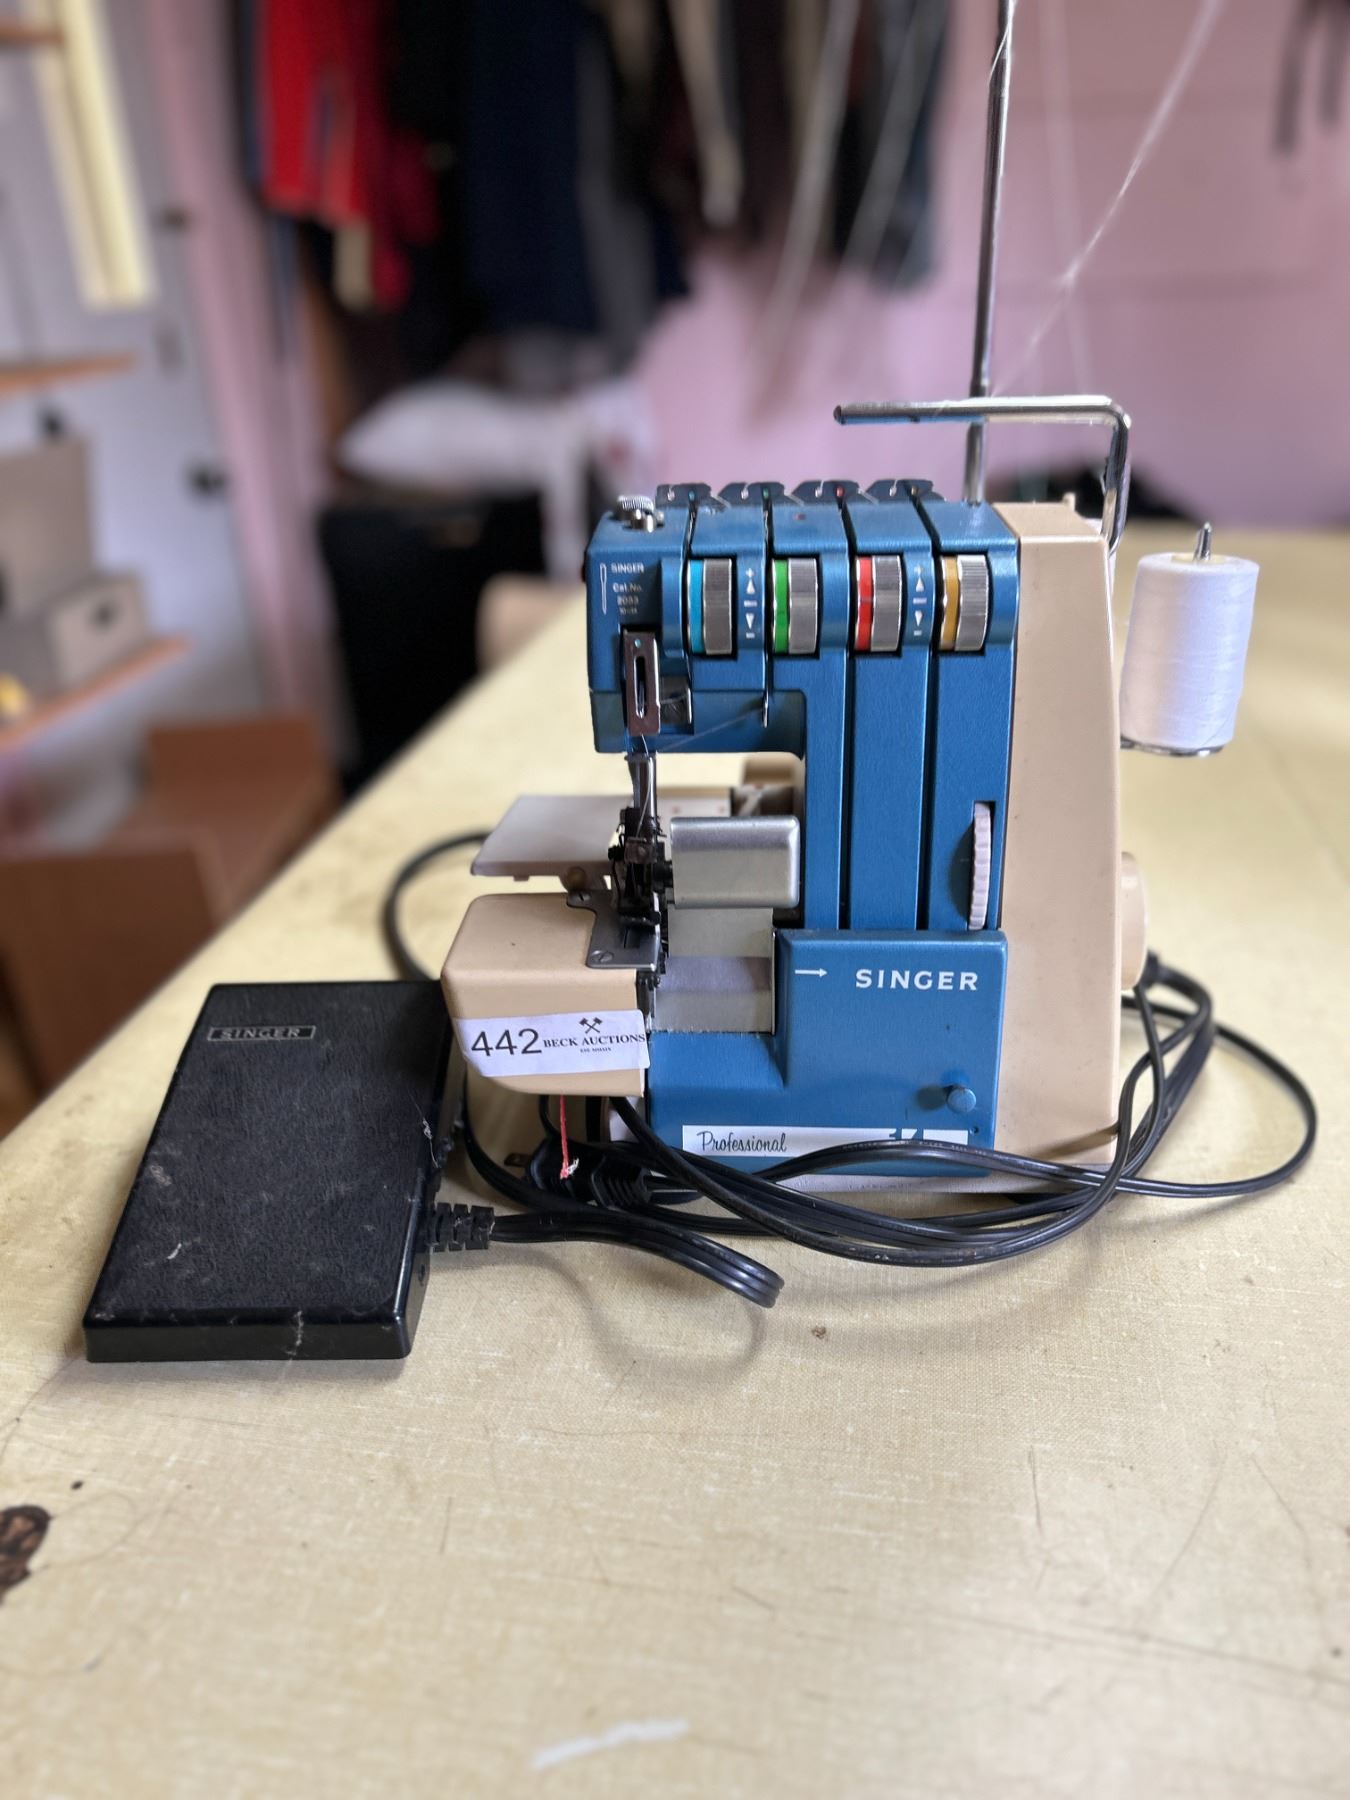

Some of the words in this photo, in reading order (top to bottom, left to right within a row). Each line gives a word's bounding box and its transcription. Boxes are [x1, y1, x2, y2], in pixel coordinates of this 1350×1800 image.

[611, 562, 645, 573] SINGER
[856, 969, 978, 991] SINGER
[221, 1027, 300, 1040] SINGER
[471, 1028, 542, 1056] 442
[543, 1036, 579, 1048] BECK
[582, 1033, 646, 1046] AUCTIONS
[697, 1131, 787, 1152] Professional
